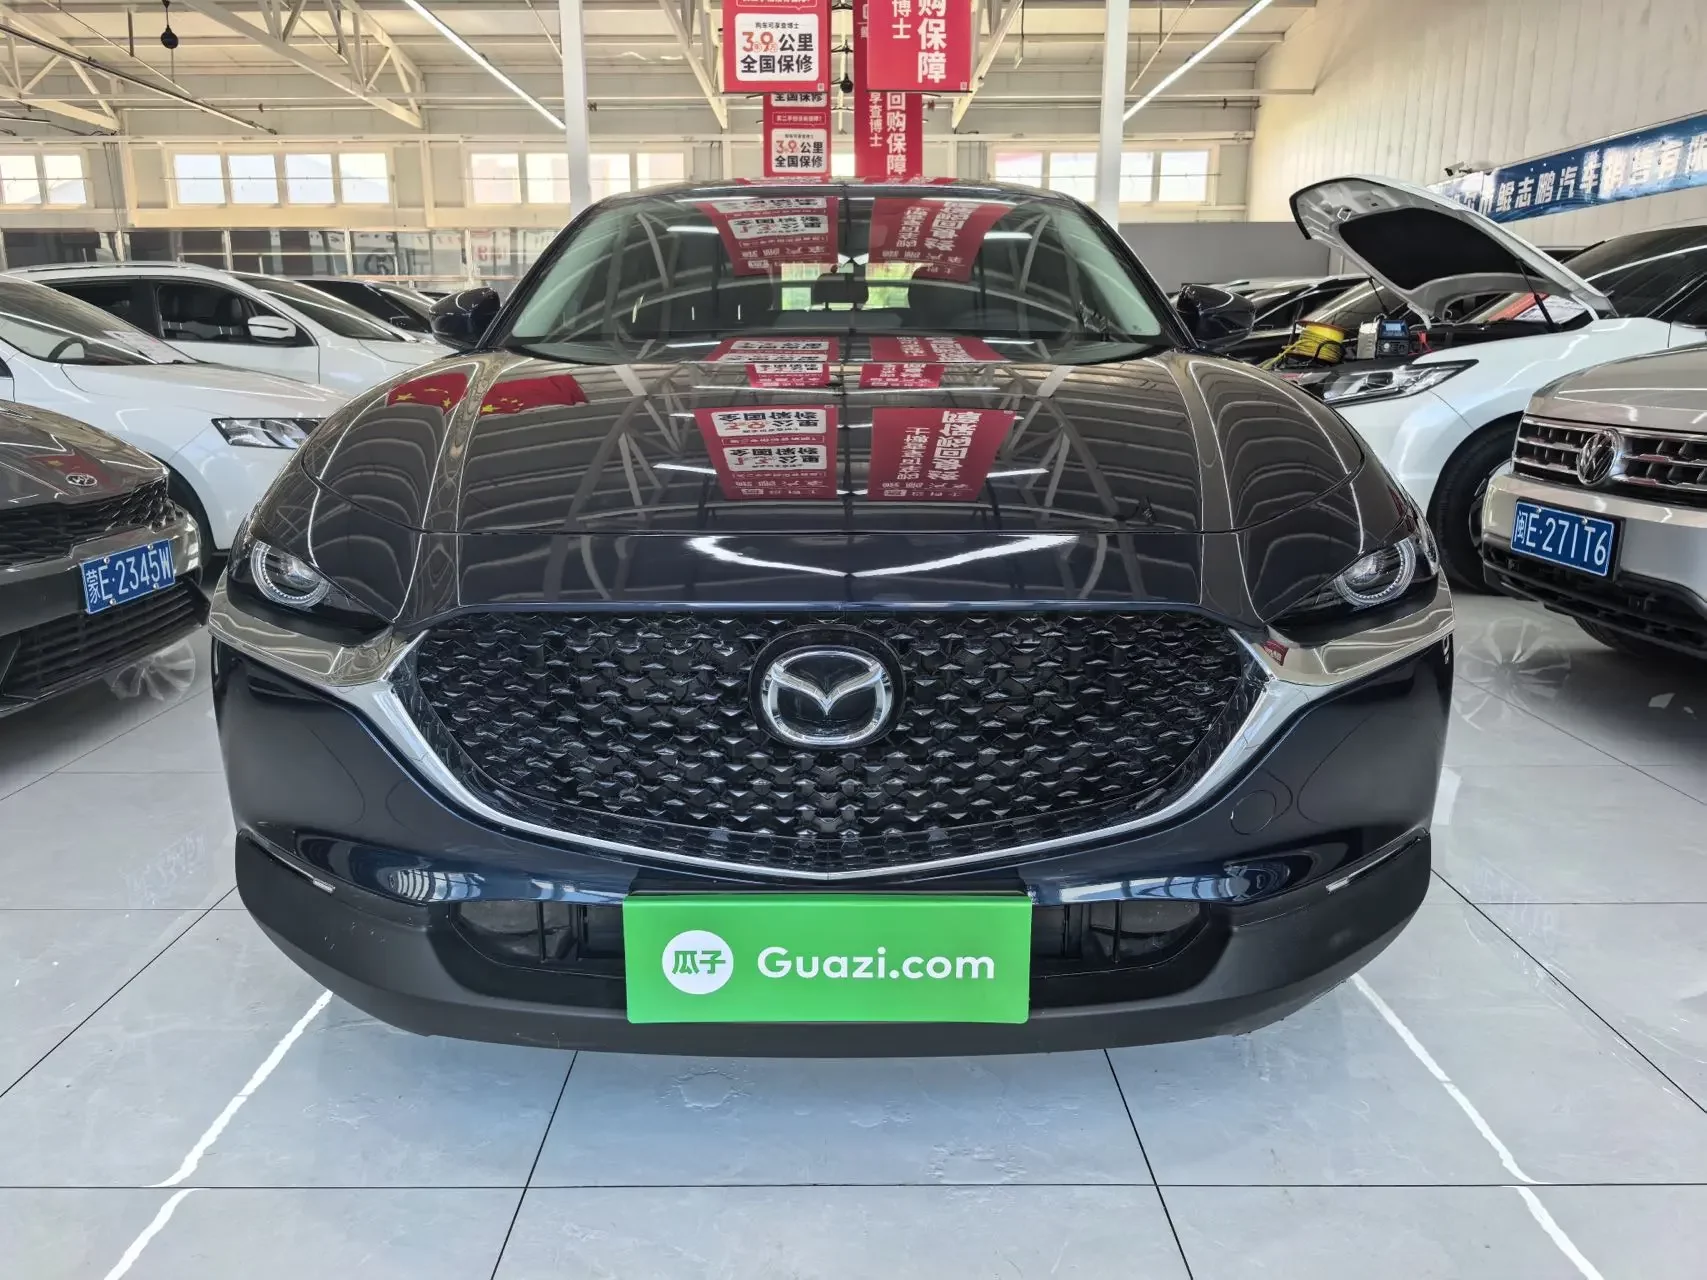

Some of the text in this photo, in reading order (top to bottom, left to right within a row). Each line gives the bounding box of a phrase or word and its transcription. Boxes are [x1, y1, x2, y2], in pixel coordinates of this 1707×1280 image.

[740, 54, 813, 74] 全国保修
[886, 92, 907, 176] 回购保障
[774, 155, 823, 168] 全国保修
[672, 950, 726, 975] 瓜子
[757, 946, 995, 980] Guazi.com
